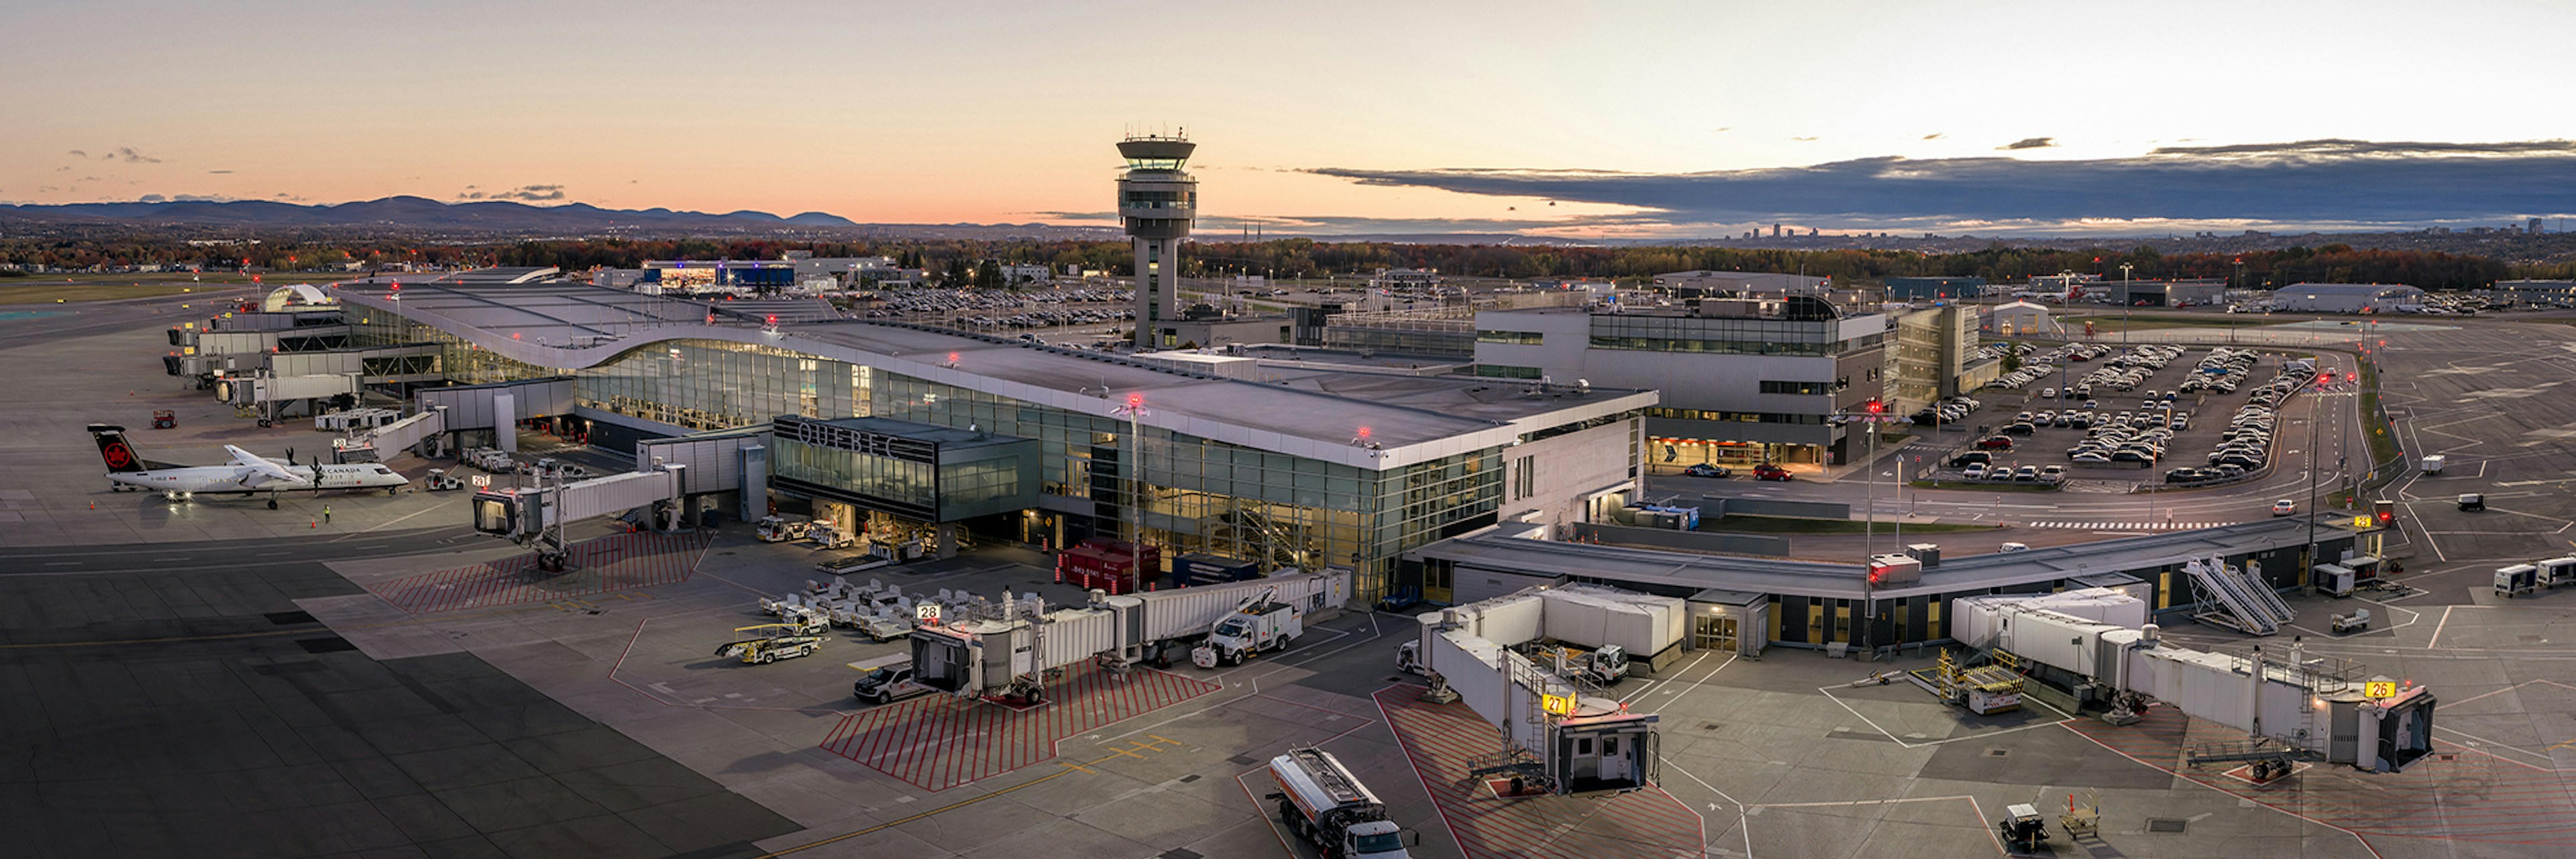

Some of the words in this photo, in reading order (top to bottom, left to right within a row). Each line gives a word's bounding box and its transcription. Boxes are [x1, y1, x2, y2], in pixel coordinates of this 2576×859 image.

[921, 607, 936, 618] 28
[2373, 683, 2387, 696] 26
[1549, 697, 1561, 711] 27
